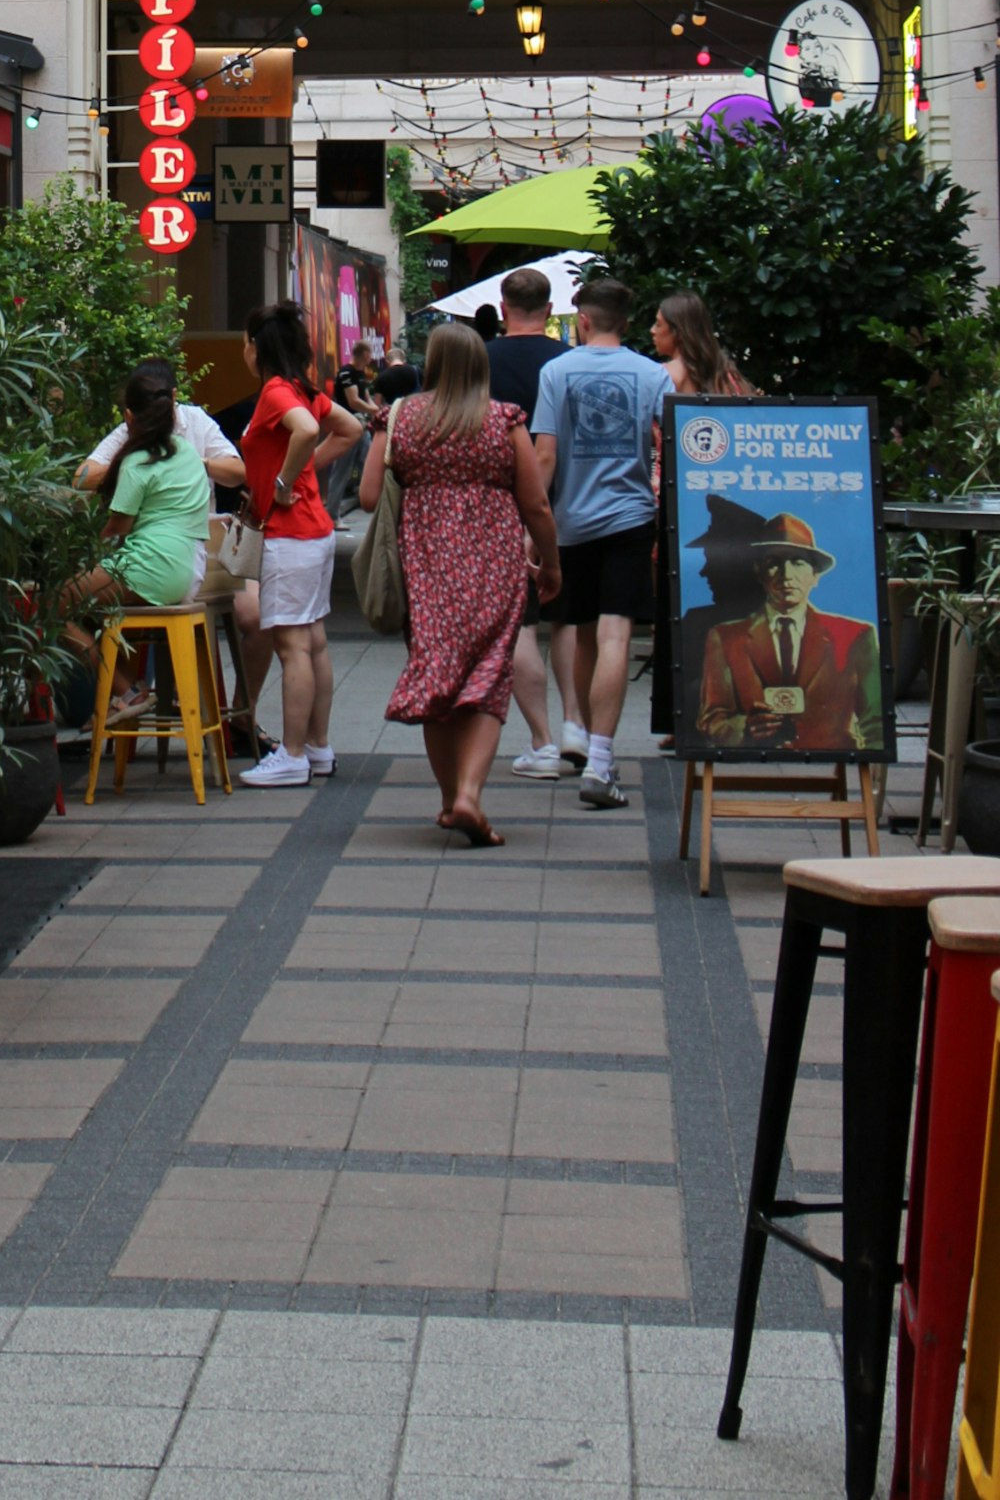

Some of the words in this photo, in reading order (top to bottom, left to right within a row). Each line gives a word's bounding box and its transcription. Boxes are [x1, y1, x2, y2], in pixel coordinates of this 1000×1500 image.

[733, 423, 800, 441] ENTRY
[805, 423, 863, 441] ONLY
[734, 441, 776, 459] FOR
[781, 441, 833, 459] REAL
